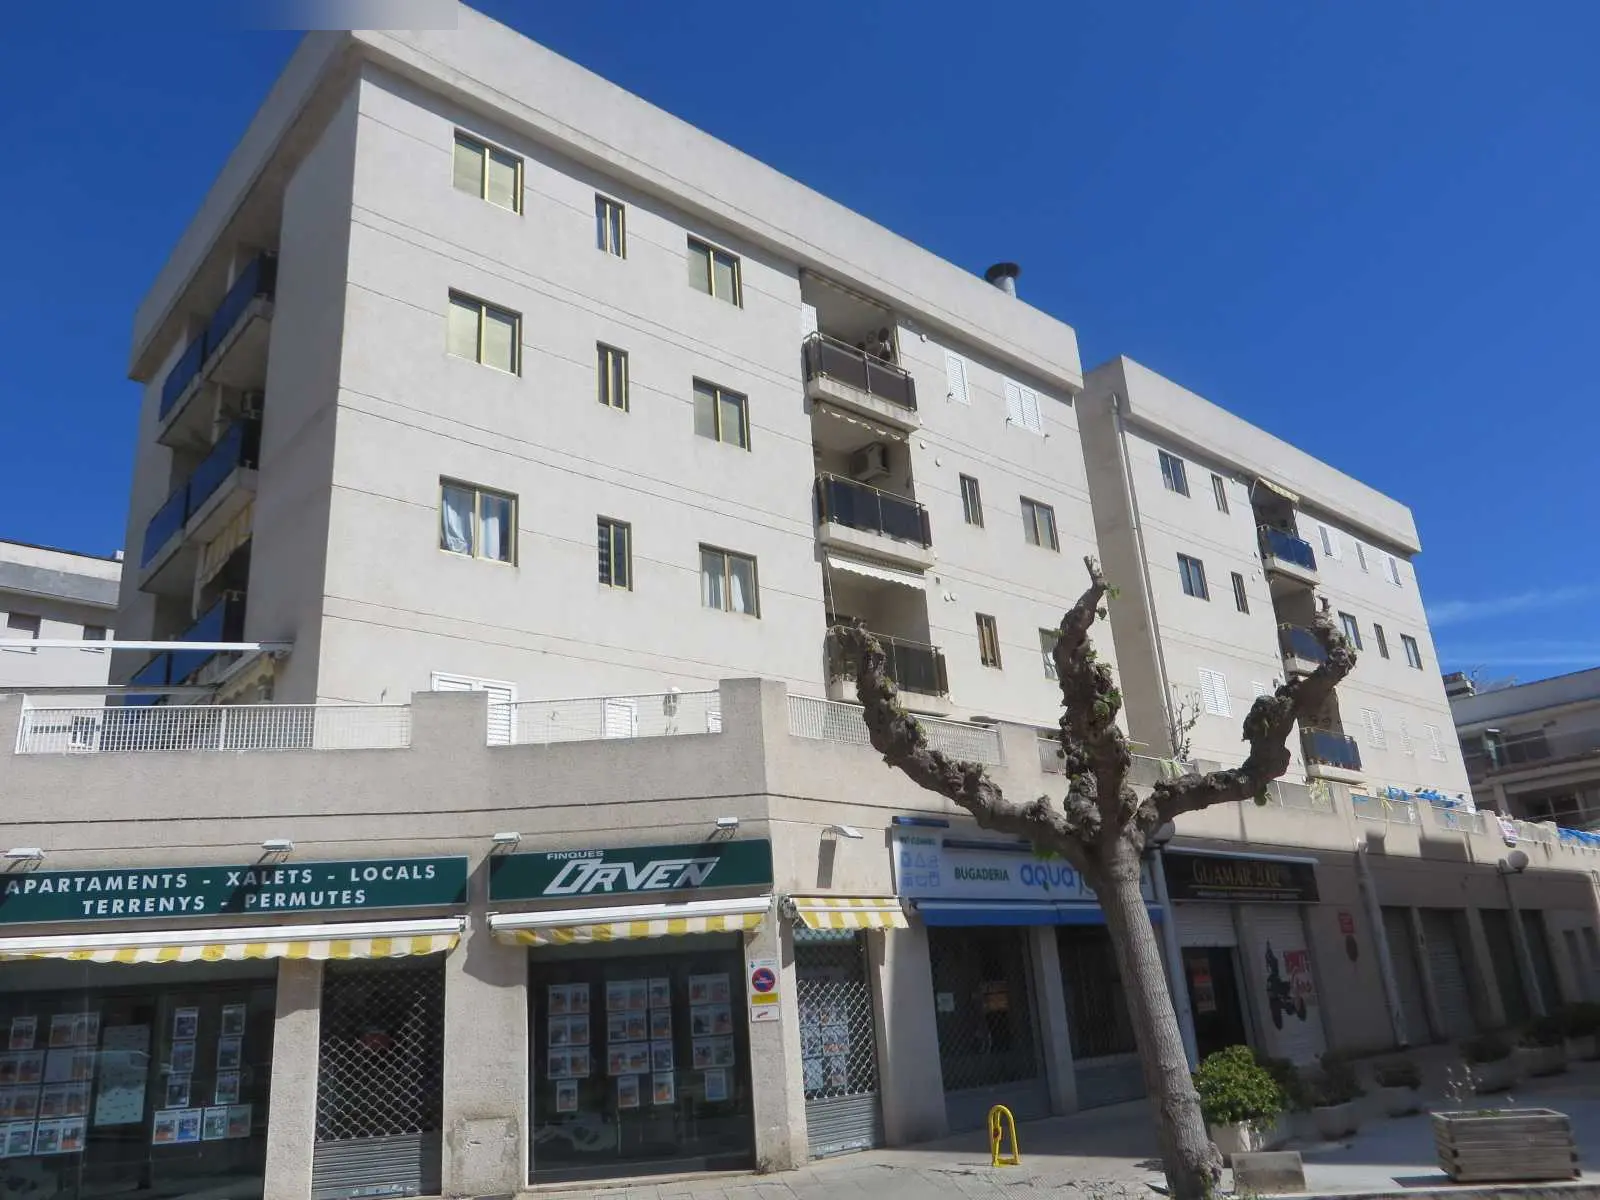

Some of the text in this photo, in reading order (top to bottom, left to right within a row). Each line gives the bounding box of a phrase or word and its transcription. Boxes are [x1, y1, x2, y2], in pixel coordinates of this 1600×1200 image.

[547, 849, 604, 861] FINQUES
[5, 873, 188, 895] APARTAMENTS
[226, 869, 313, 887] XALETS
[350, 864, 437, 881] LOCALS
[543, 857, 720, 895] ORVEN
[954, 866, 1009, 882] BUGADERIA
[82, 895, 206, 915] TERRENYS
[245, 889, 367, 909] PERMUTES
